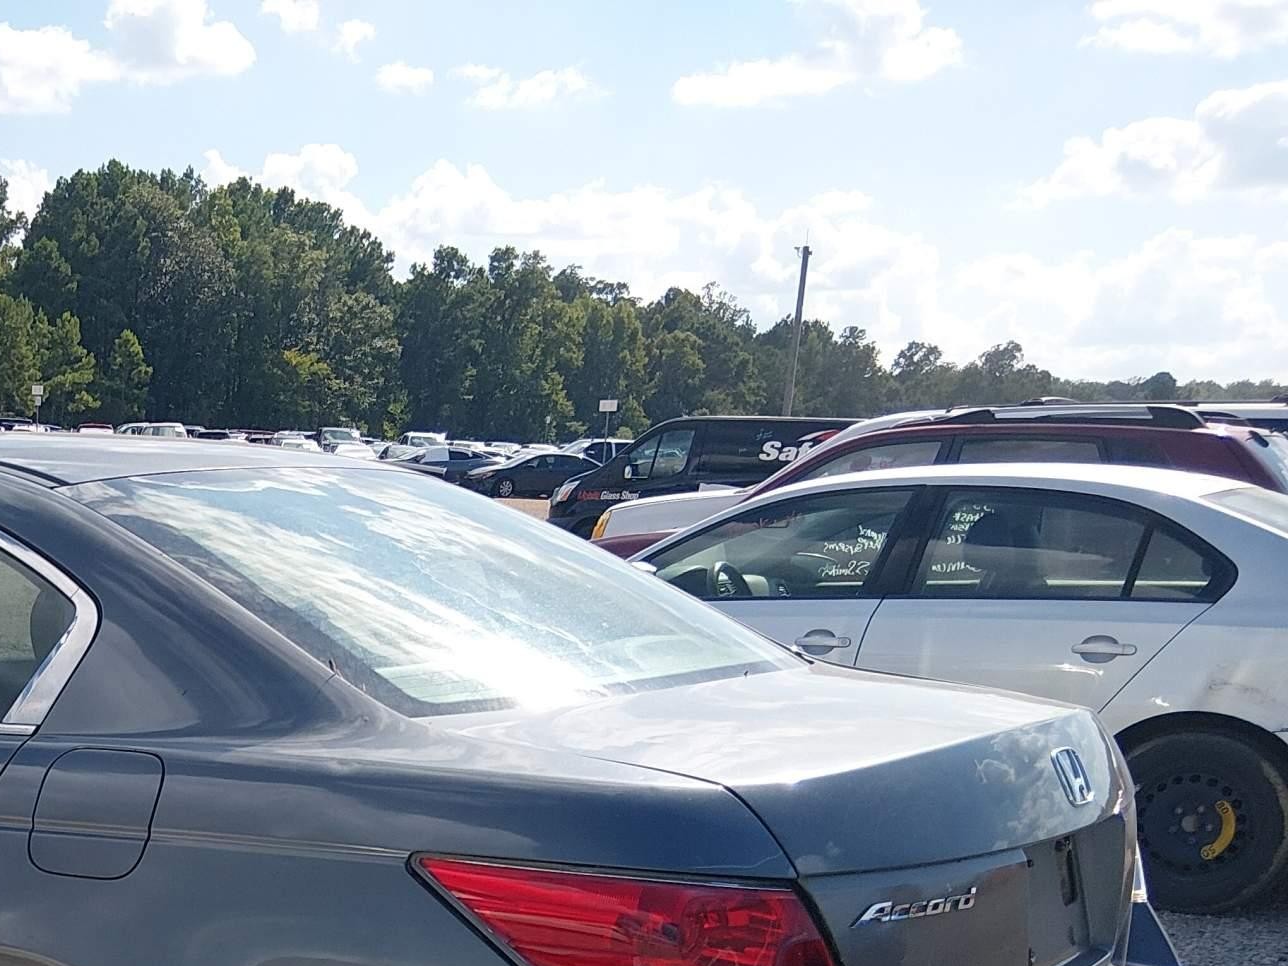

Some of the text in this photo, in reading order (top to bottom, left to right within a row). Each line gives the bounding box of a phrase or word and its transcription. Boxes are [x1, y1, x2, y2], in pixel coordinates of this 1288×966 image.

[600, 490, 620, 500] Glass
[620, 490, 639, 500] Shop
[849, 887, 977, 928] Accord
